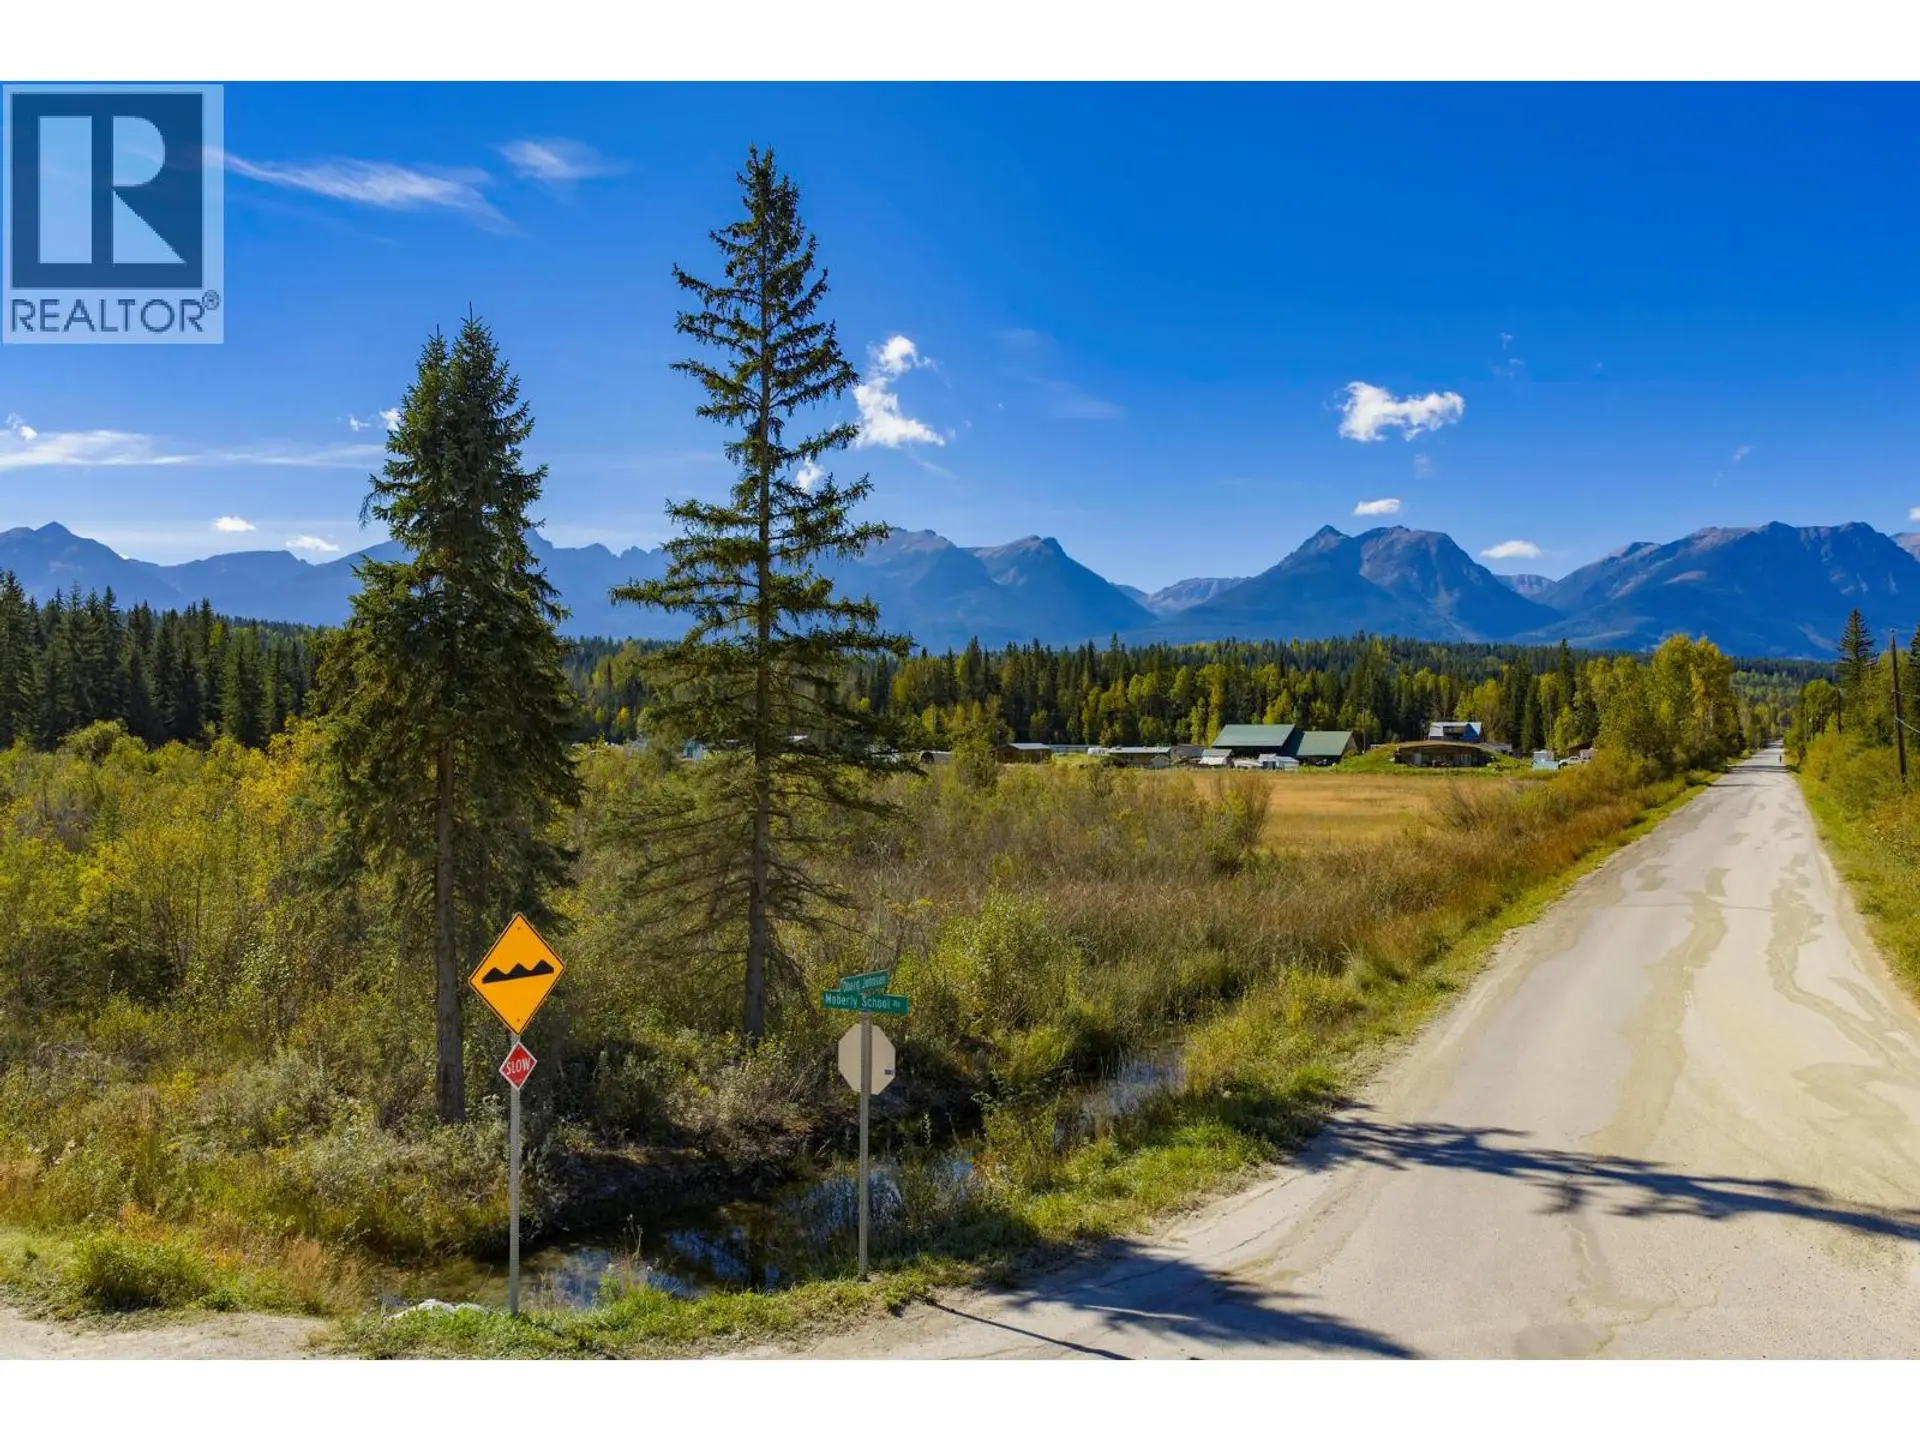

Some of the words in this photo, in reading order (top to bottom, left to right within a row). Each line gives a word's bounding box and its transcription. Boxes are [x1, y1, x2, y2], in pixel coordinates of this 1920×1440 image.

[825, 992, 858, 1009] Moberly
[861, 995, 891, 1009] School
[506, 1057, 531, 1076] SLOW
